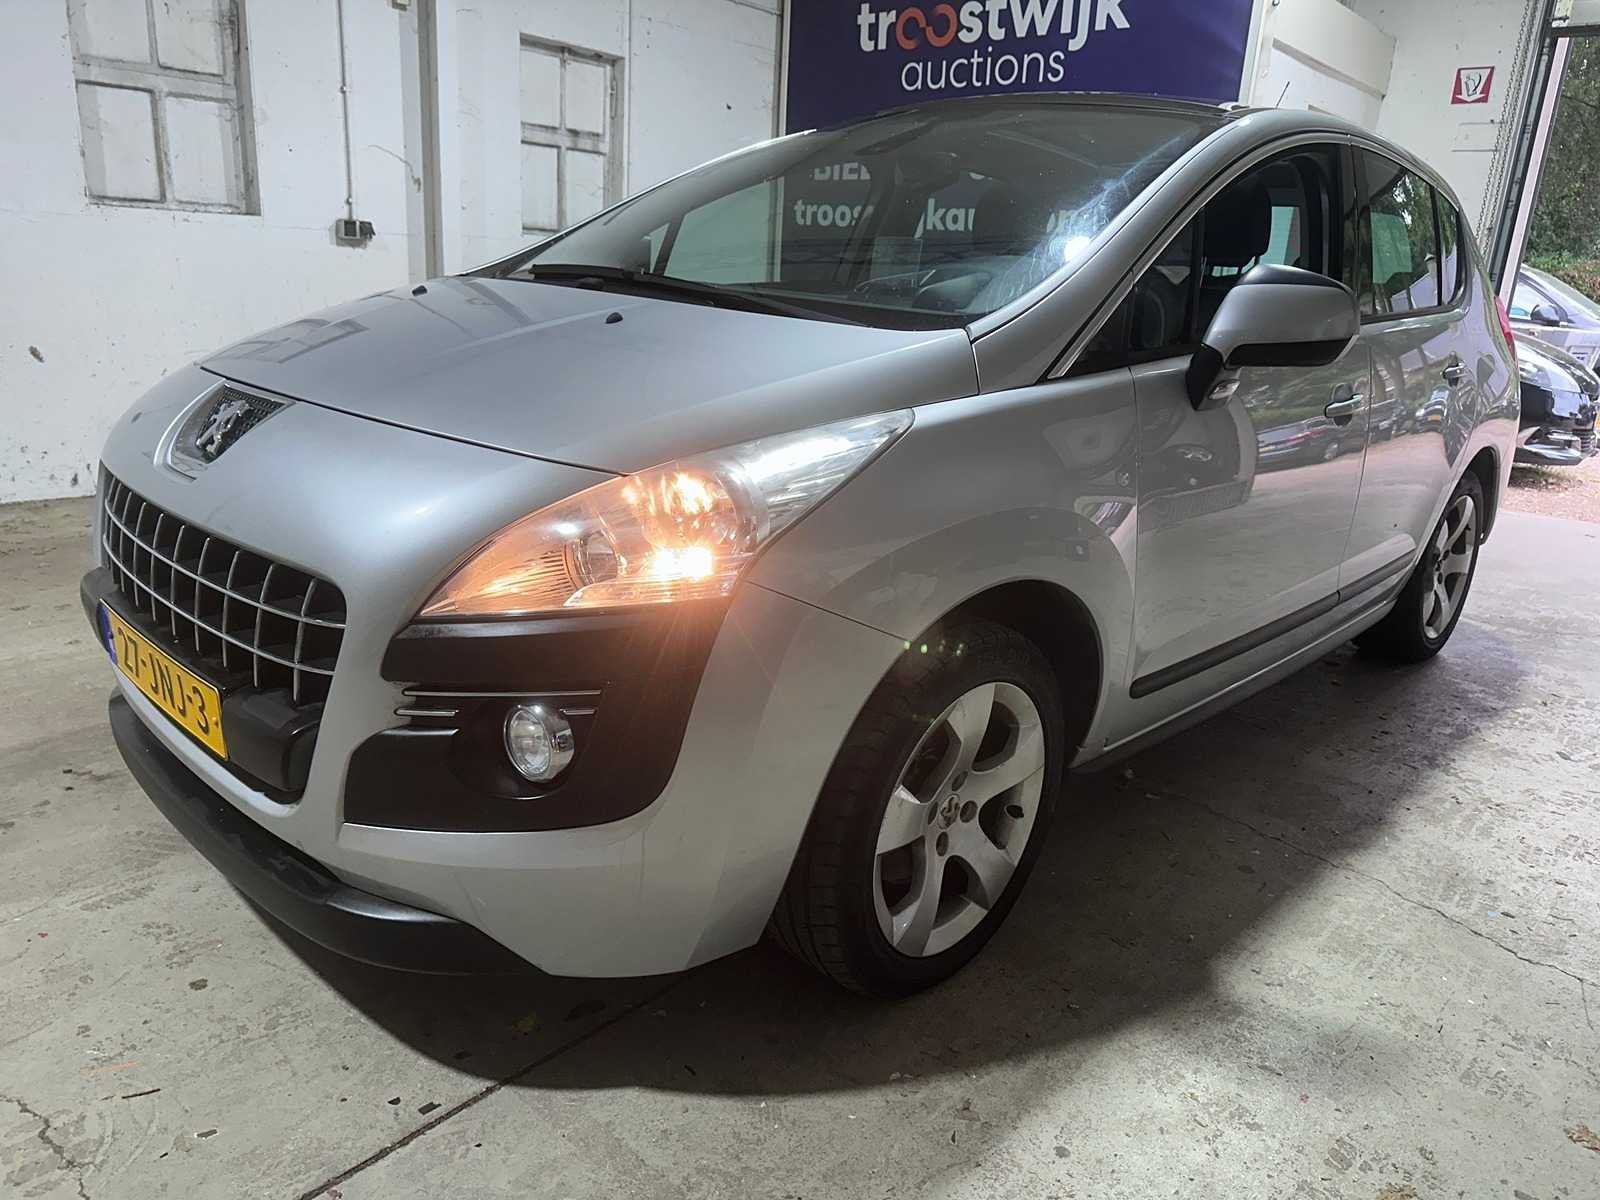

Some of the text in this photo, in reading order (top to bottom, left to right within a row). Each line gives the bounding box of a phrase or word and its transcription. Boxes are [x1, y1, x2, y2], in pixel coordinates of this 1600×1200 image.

[857, 0, 1130, 52] troostwijk
[901, 46, 1065, 91] auctions
[117, 626, 210, 735] 27-JNJ-3
